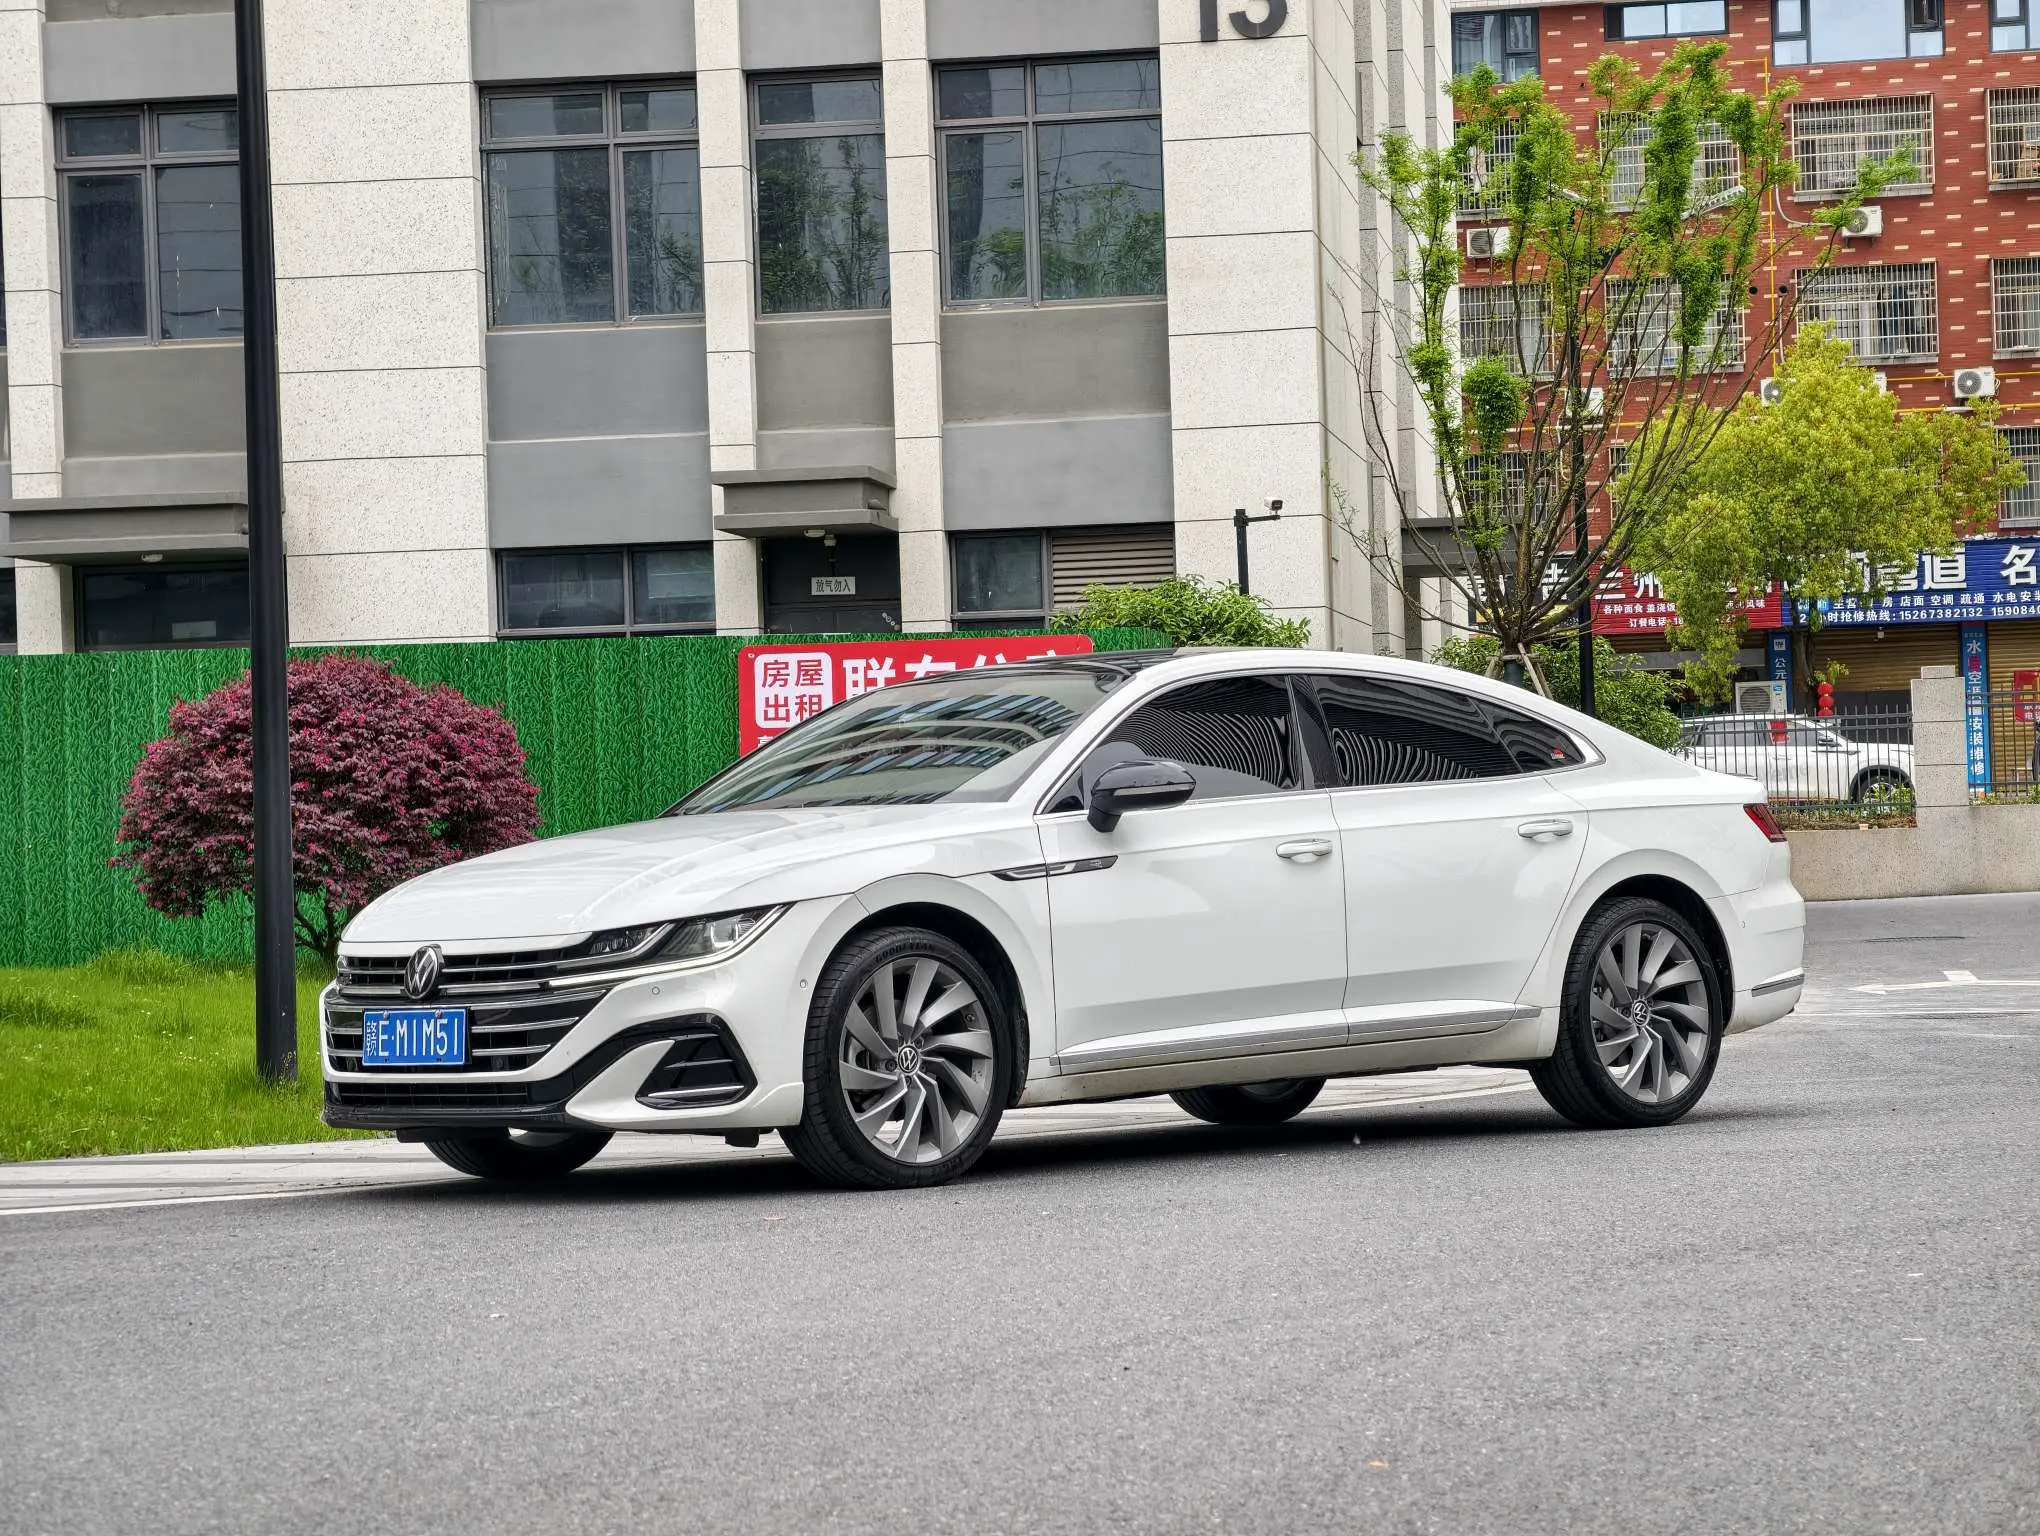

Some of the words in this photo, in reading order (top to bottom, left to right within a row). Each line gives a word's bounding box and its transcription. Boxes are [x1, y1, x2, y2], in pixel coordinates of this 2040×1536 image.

[2000, 545, 2038, 586] 名
[816, 579, 850, 593] 放气勿入
[1603, 603, 1643, 615] 各种面食
[1900, 595, 1925, 607] 店面
[1930, 593, 1954, 606] 空调
[1960, 592, 1985, 605] 疏通
[1629, 617, 1667, 628] 订餐电话
[761, 659, 824, 688] 房屋
[1774, 657, 1788, 680] 公元
[763, 693, 823, 724] 出租
